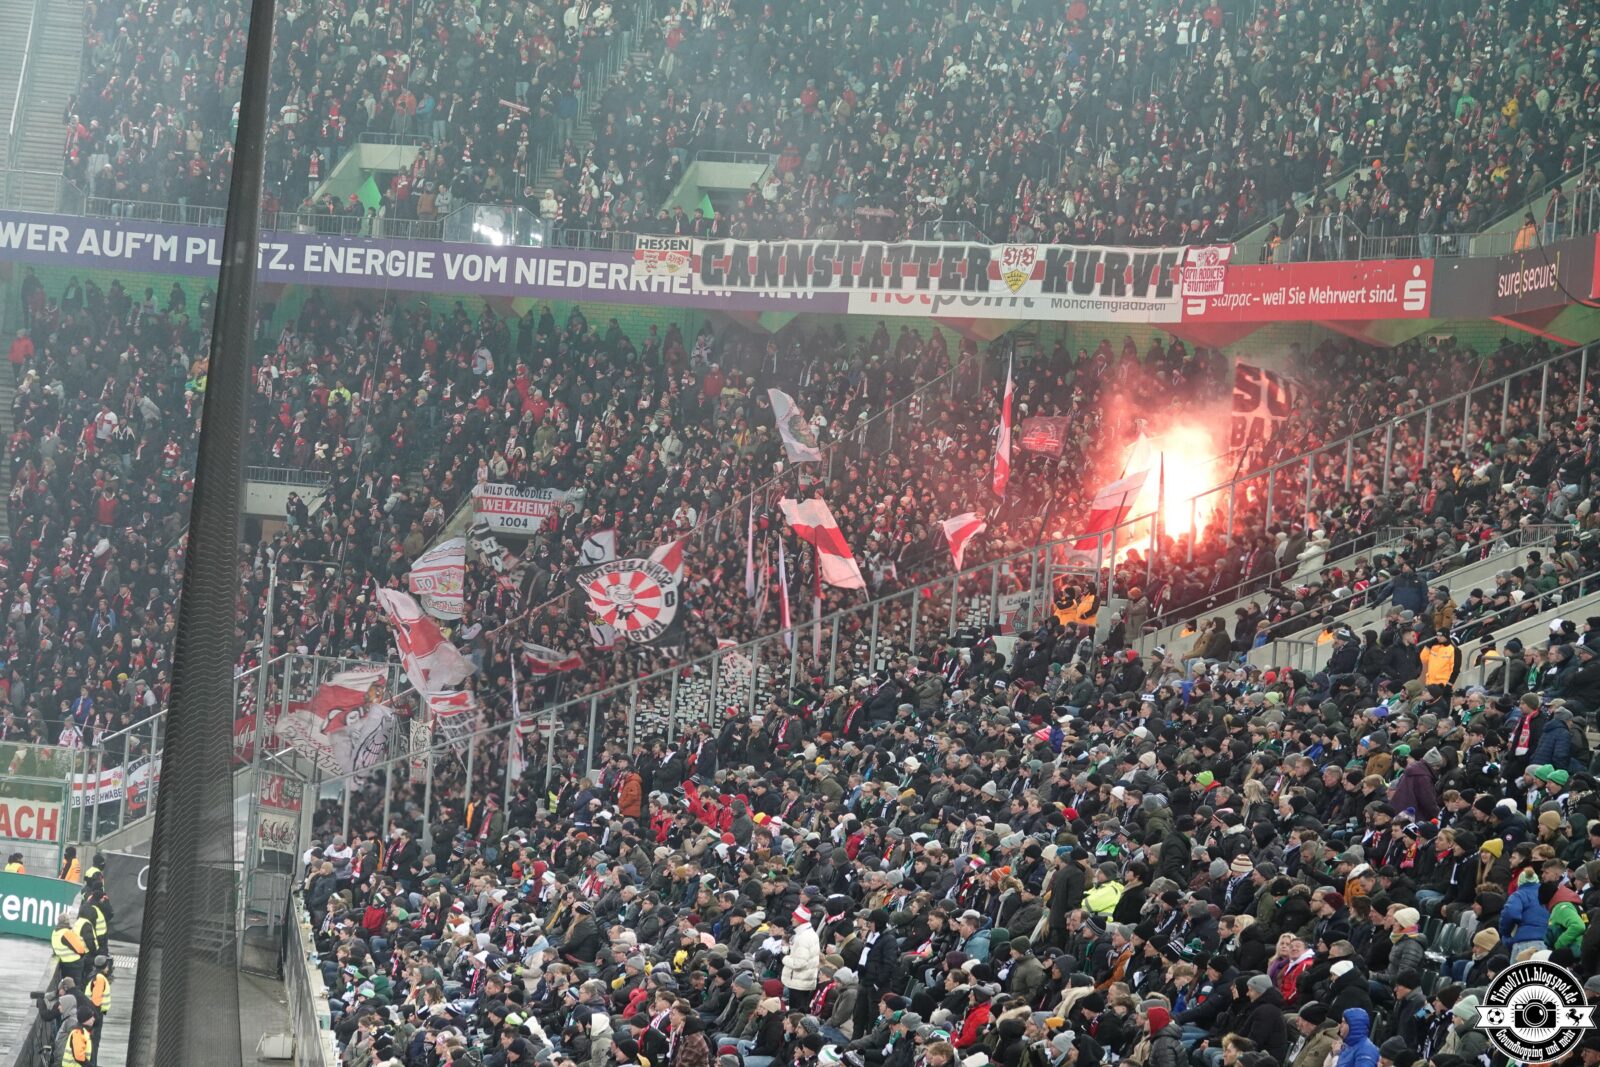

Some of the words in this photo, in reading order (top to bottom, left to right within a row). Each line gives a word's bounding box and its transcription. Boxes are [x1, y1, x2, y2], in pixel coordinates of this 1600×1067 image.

[0, 222, 69, 253] WER
[76, 228, 178, 262] AUF'M
[185, 237, 295, 271] PLTZ.
[304, 245, 435, 280] ENERGIE
[443, 252, 510, 284] VOM
[638, 238, 690, 252] HESSEN
[700, 243, 991, 292] CANNSTATTER
[1041, 245, 1176, 298] KURVE
[1187, 280, 1220, 292] STUTTGART
[1263, 286, 1286, 306] weil
[1289, 286, 1306, 305] Sie
[1309, 285, 1366, 304] Mehrwert
[1369, 284, 1398, 304] sind.
[483, 486, 502, 497] WILD
[504, 487, 553, 499] CROCODILES
[482, 499, 550, 517] WELZHEIM
[499, 516, 528, 528] 2004
[0, 804, 59, 841] ACH
[0, 894, 74, 927] ennu
